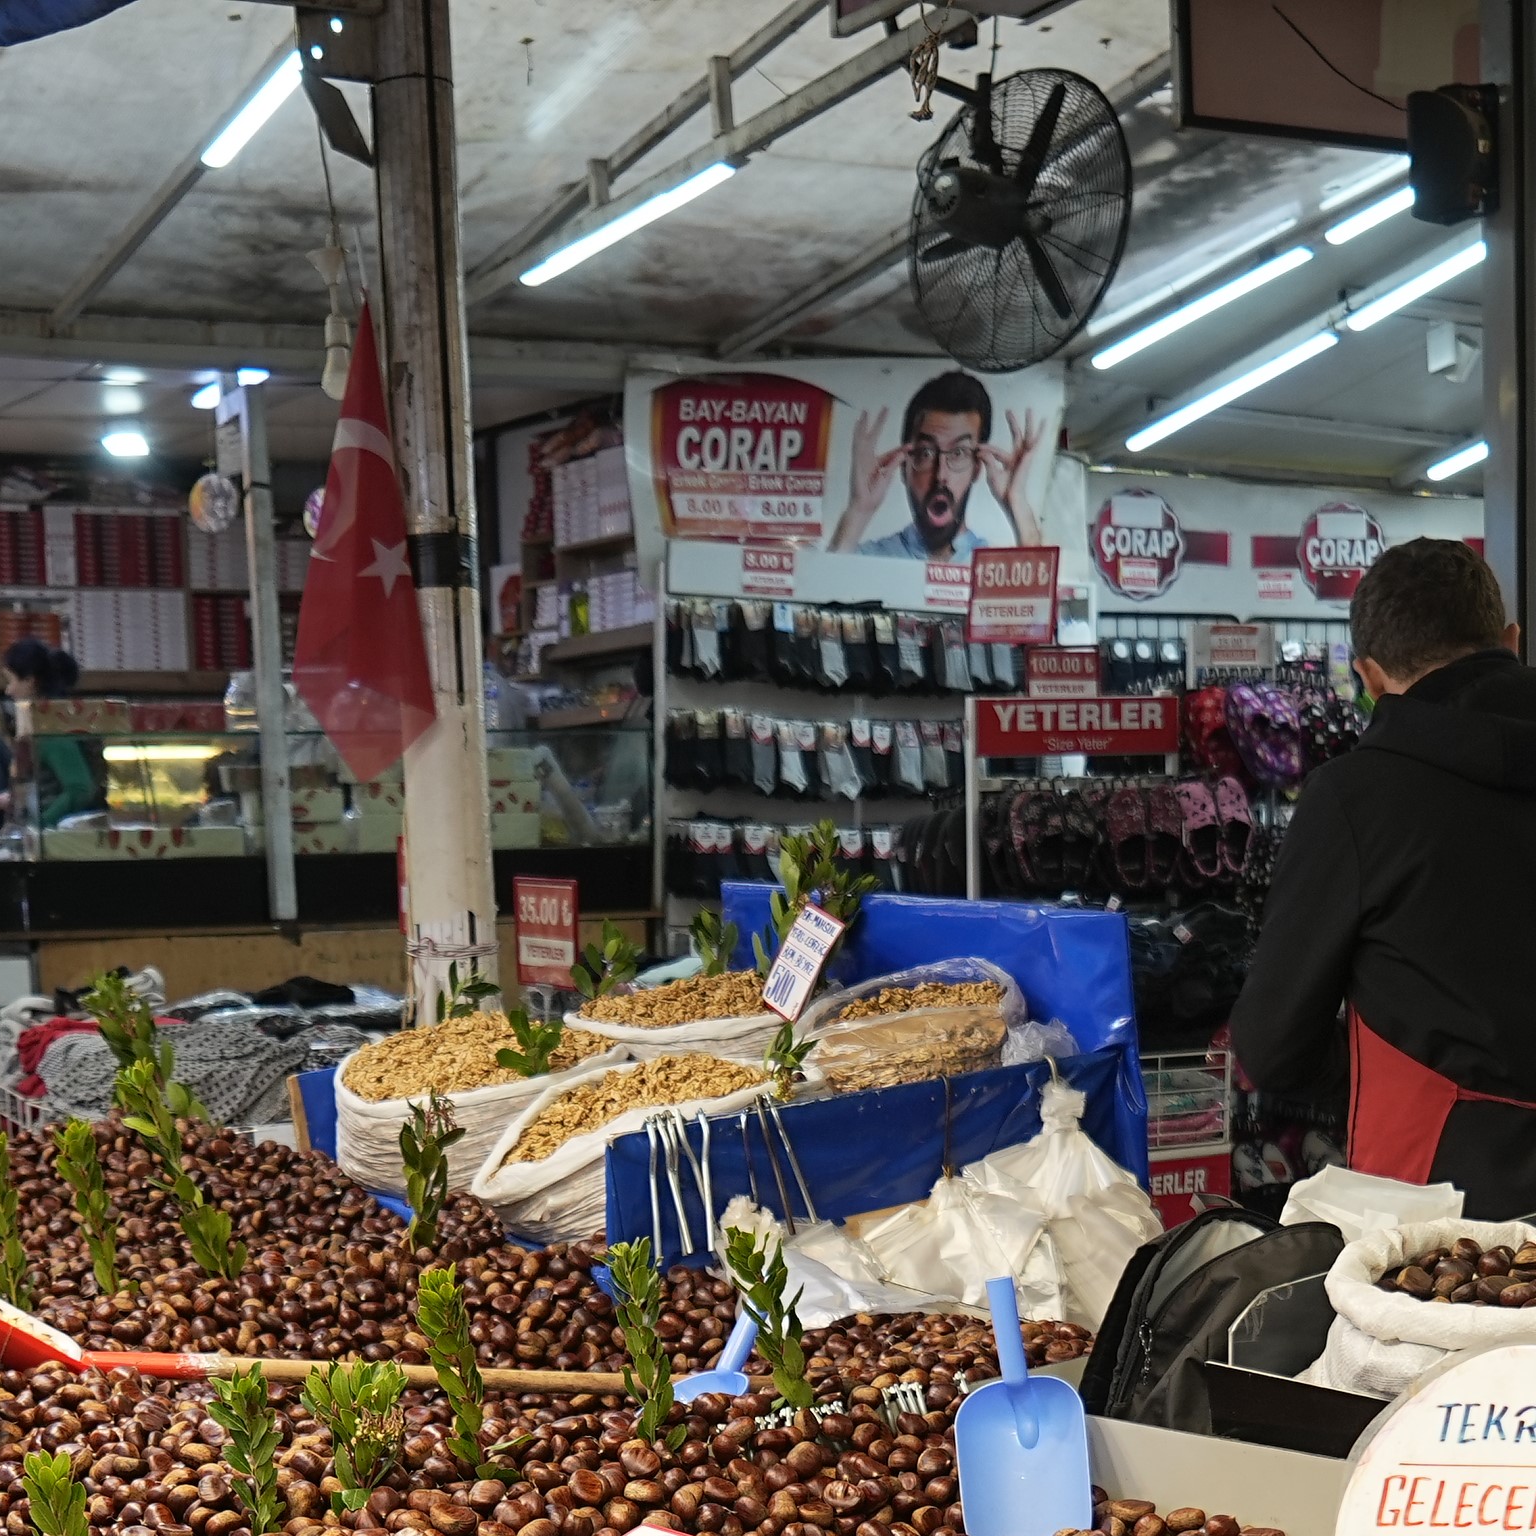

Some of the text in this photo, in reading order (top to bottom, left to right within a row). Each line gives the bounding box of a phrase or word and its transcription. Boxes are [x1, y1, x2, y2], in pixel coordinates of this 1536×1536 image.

[679, 398, 808, 424] BAY-BAYAN
[1100, 526, 1176, 563] ÇORAP
[976, 561, 1032, 588] 150.00
[978, 604, 1034, 618] YETERLER
[1030, 656, 1080, 674] 100.00
[993, 702, 1164, 732] YETERLER
[519, 895, 559, 927] 35.00
[765, 963, 797, 1008] 500
